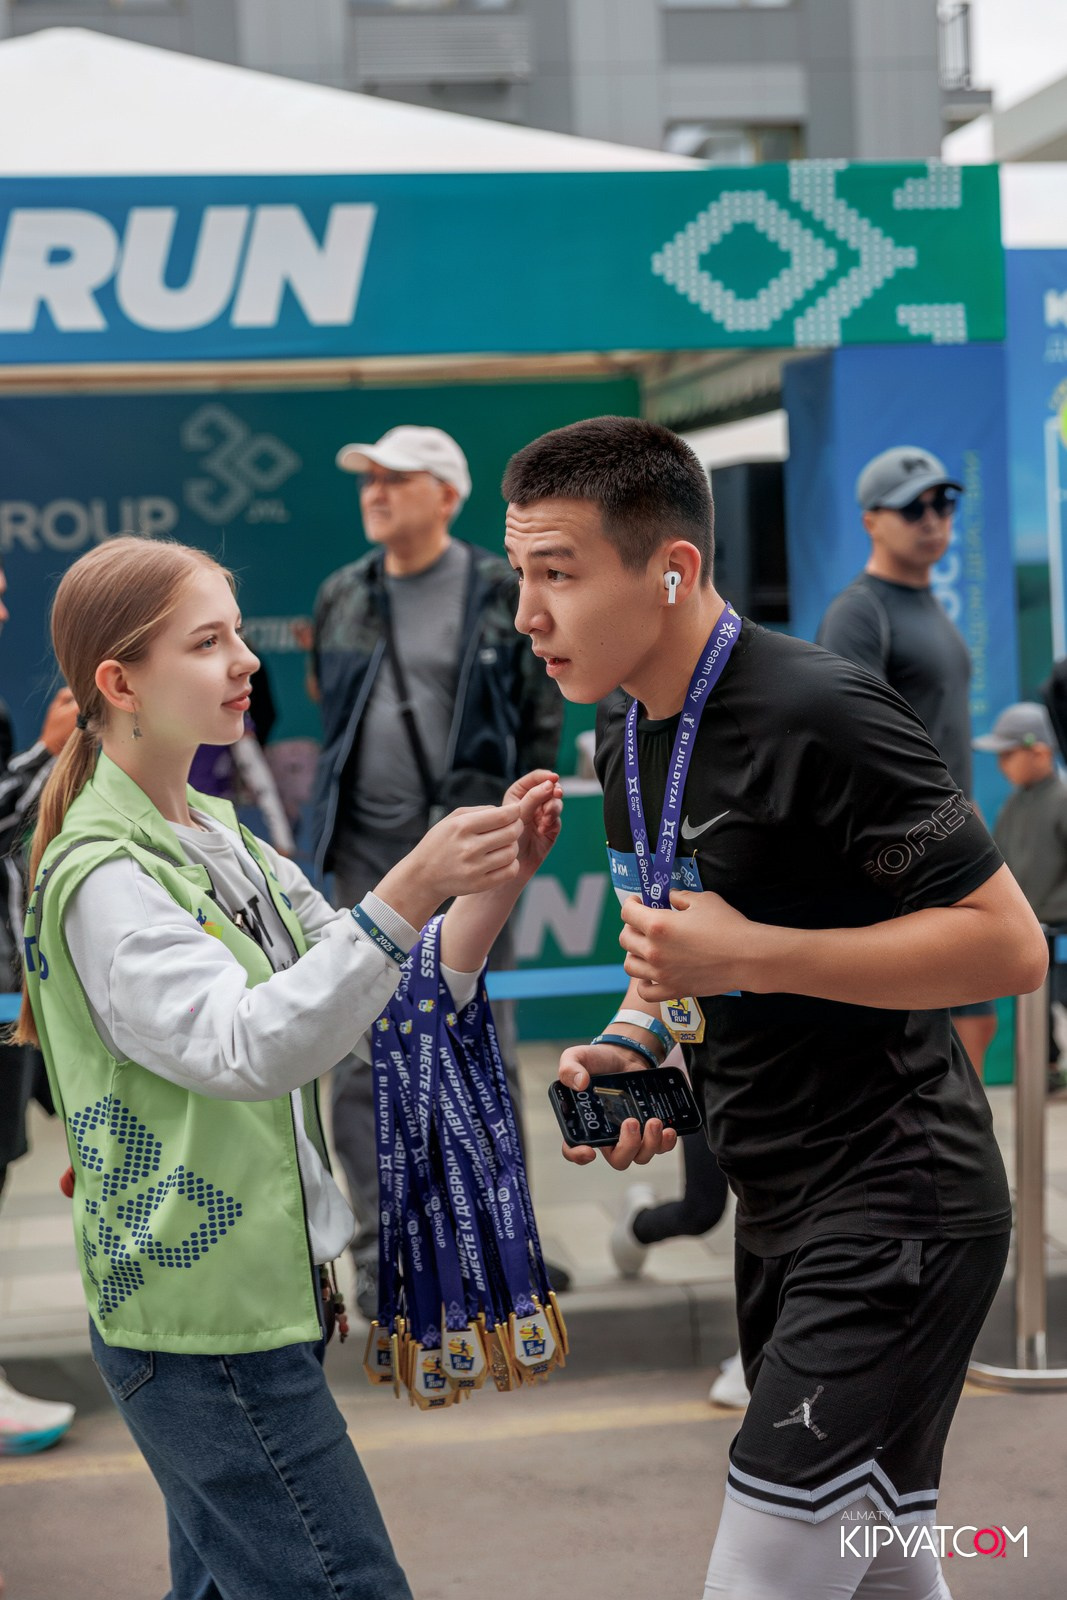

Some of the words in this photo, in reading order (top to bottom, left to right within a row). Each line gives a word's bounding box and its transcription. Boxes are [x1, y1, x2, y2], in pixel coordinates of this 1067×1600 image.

[0, 203, 377, 334] RUN
[701, 636, 729, 675] Dream
[689, 678, 708, 703] City
[680, 731, 689, 745] BI
[668, 747, 686, 809] JULDYZAI
[636, 841, 644, 856] BI
[660, 838, 668, 854] City
[665, 840, 674, 863] Arena
[611, 858, 618, 874] 5
[651, 885, 661, 899] BI
[376, 935, 394, 952] 2025
[421, 914, 445, 978] PPINESS
[400, 971, 412, 995] Dre
[464, 1002, 479, 1025] City
[674, 1015, 688, 1023] RUN
[390, 1051, 411, 1093] ВМЕС
[420, 1033, 433, 1091] ВМЕСТЕ
[379, 1076, 388, 1087] BI
[379, 1089, 389, 1144] JULDYZAI
[576, 1091, 600, 1130] 08:40
[472, 1118, 498, 1179] ДОБРЫ
[446, 1150, 472, 1218] ДОБРЫМ
[498, 1188, 510, 1202] BI
[434, 1212, 446, 1248] GROUP
[502, 1203, 515, 1239] GROUP
[411, 1236, 423, 1272] GROUP
[463, 1233, 486, 1292] ВМЕСТЕ
